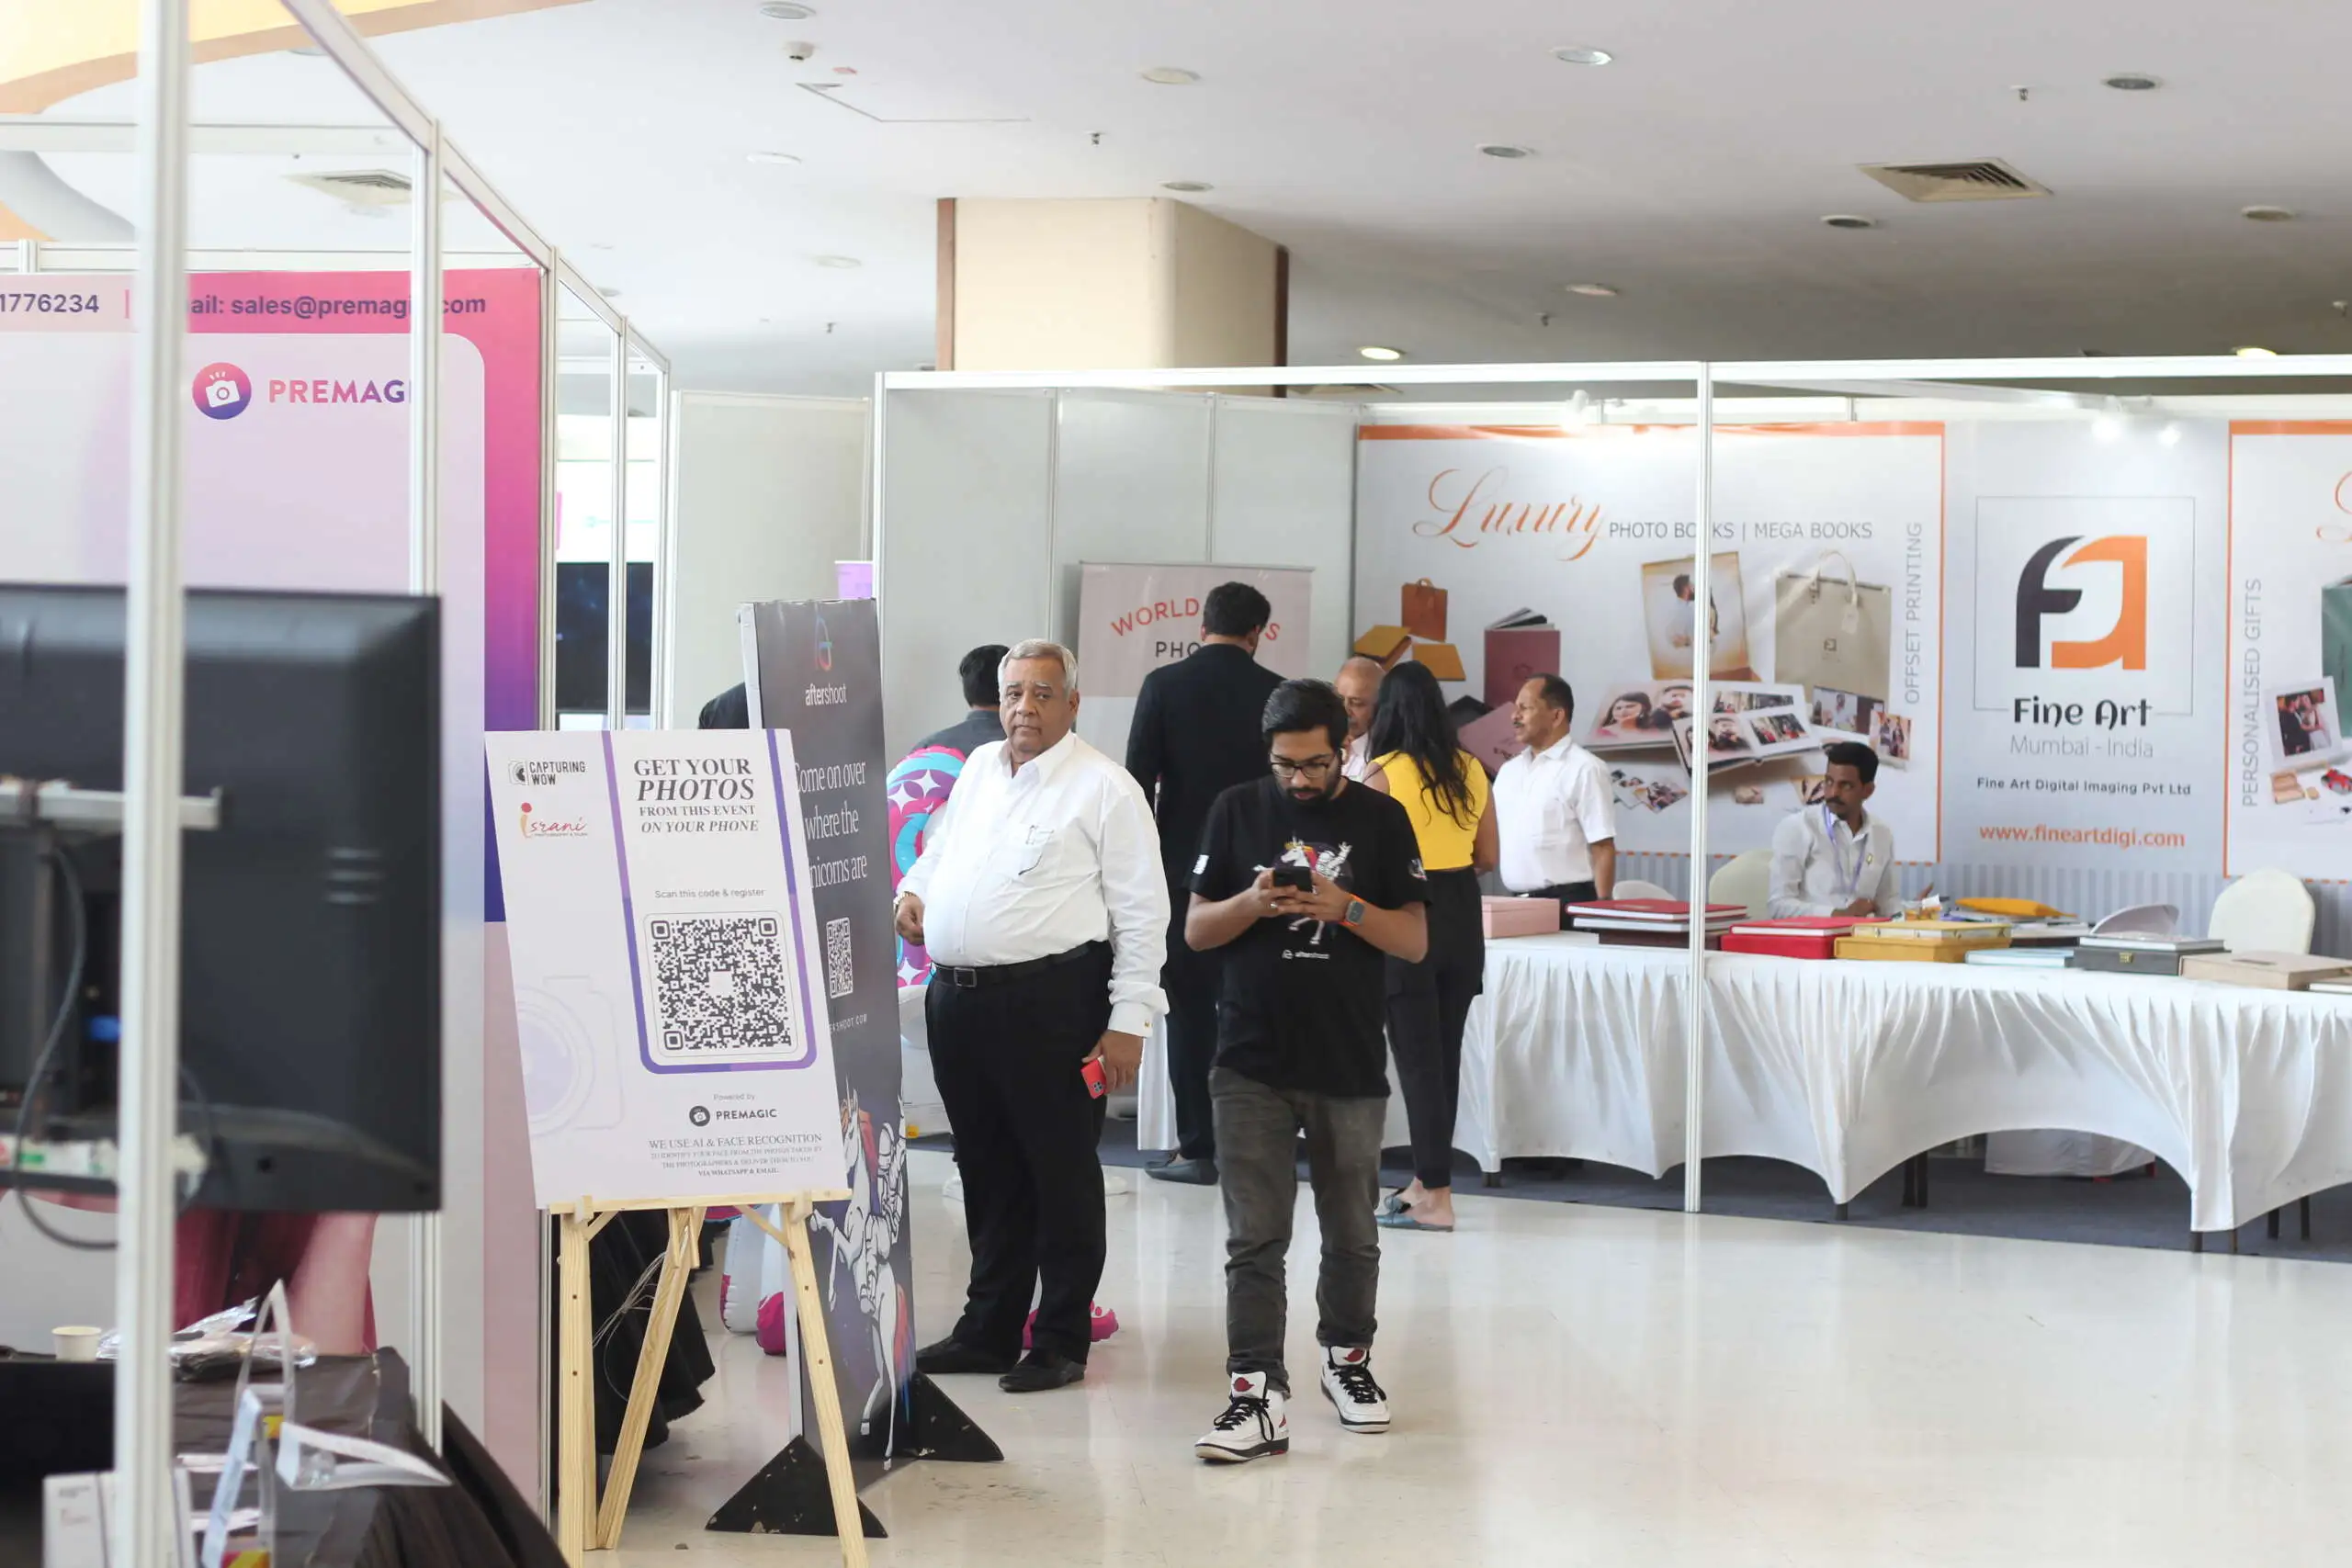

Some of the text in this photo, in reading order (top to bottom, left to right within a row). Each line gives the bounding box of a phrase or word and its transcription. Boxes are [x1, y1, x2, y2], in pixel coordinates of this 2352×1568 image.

[187, 296, 224, 314] ail:
[269, 379, 411, 403] PREMAG
[1412, 466, 1606, 561] Luxury
[1610, 522, 1668, 538] PHOTO
[1674, 522, 1735, 539] BOKS
[1754, 522, 1804, 538] MEGA
[1810, 522, 1872, 538] BOOKS
[1111, 598, 1200, 637] WORLD
[1905, 522, 1922, 705] OFFSET PRINTING
[1156, 641, 1203, 659] PHO
[805, 683, 847, 705] aftershoot
[2243, 578, 2261, 807] PERSONALISED GIFTS
[2014, 695, 2153, 730] Fine Art
[2010, 734, 2090, 757] Mumbai
[2108, 736, 2154, 759] India
[529, 761, 586, 773] CAPTURING
[634, 758, 752, 776] GET YOUR
[828, 765, 842, 790] on
[843, 761, 866, 787] over
[531, 773, 556, 785] WOW
[1977, 777, 2191, 795] Fine Art Digital Imaging Pvt Ltd
[637, 778, 754, 801] PHOTOS
[639, 805, 756, 816] FROM THIS EVENT
[805, 800, 859, 840] where the
[641, 820, 759, 833] ON YOUR PHONE
[1980, 824, 2186, 850] www.fineartdigi.com
[808, 854, 868, 889] nicorns are
[654, 887, 765, 898] Scan this code & register
[713, 1093, 755, 1102] Powered by
[716, 1109, 778, 1121] PREMAGIC
[649, 1133, 822, 1150] WE USE AI & FACE RECOGNITION
[711, 1168, 749, 1176] WHATSAPP
